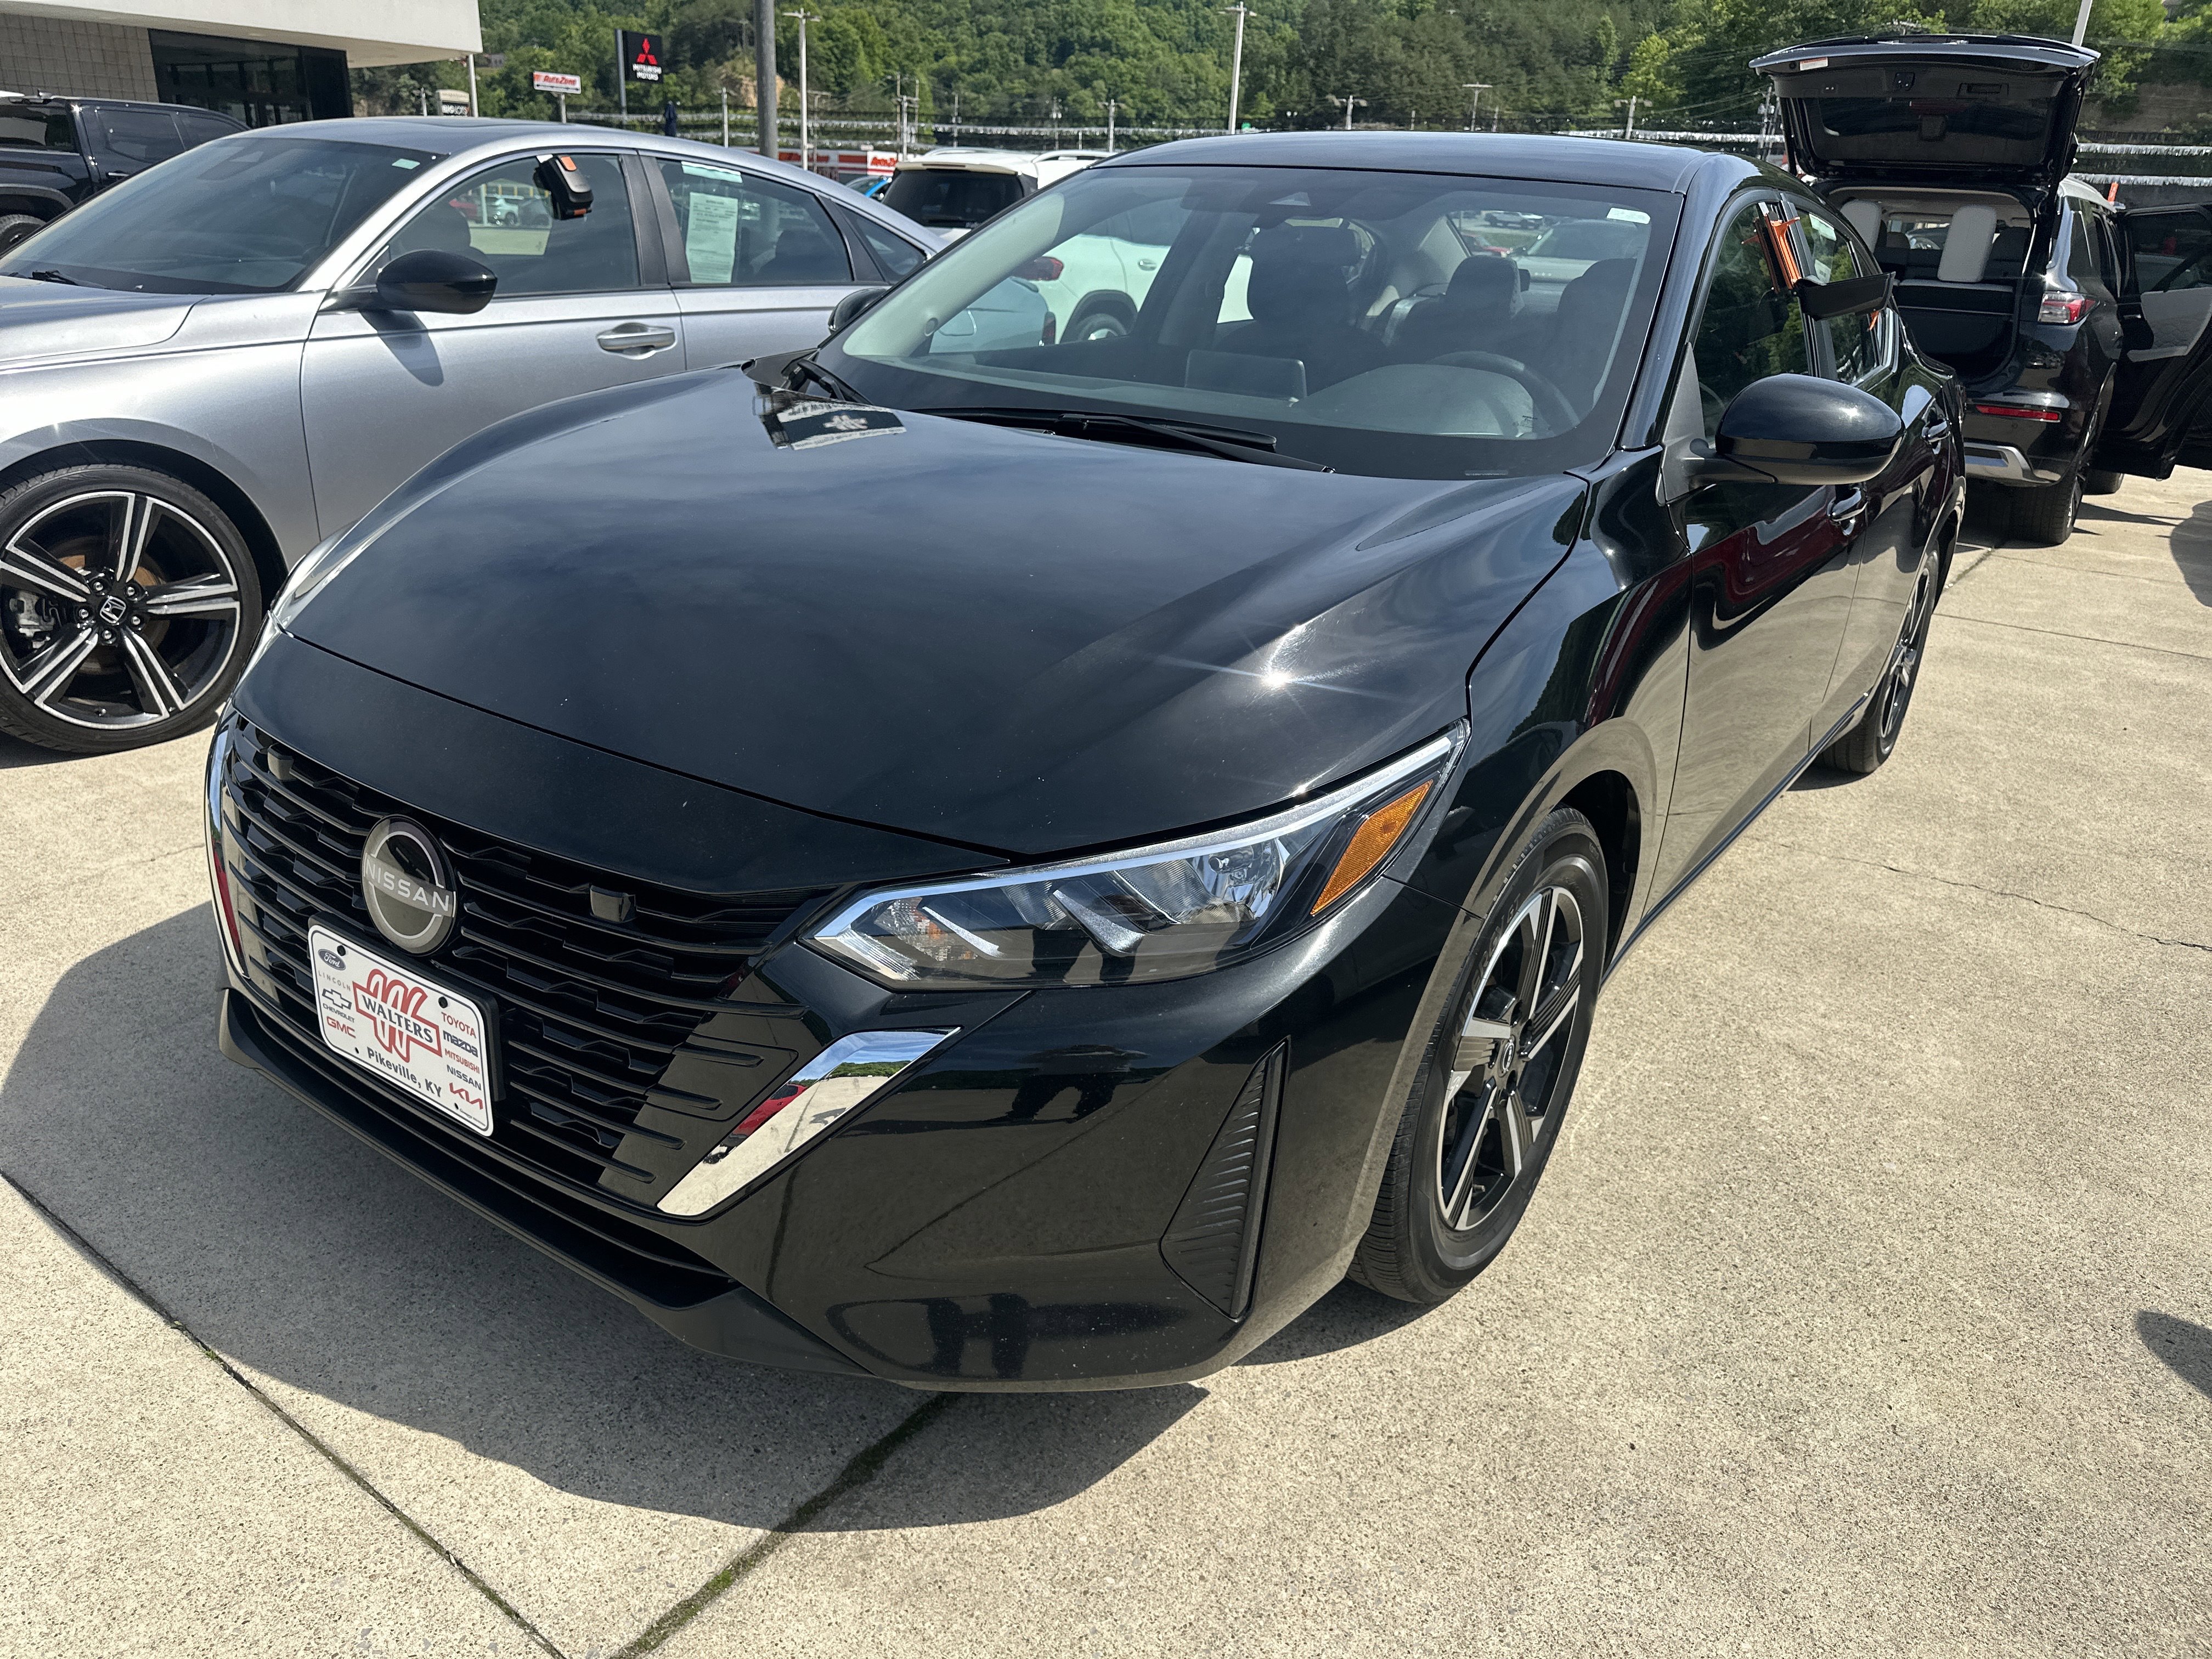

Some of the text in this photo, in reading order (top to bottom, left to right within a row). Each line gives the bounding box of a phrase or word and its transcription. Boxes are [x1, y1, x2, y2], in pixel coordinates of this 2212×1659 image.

[544, 75, 577, 86] AutoZone
[365, 859, 449, 911] NISSAN
[324, 952, 341, 968] Ford
[318, 970, 351, 991] LINCOLN
[323, 1003, 354, 1023] CHEVROLET
[362, 994, 433, 1043] WALTERS
[441, 1012, 477, 1039] TOYOTA
[326, 1016, 356, 1039] GMC
[366, 1046, 442, 1097] Pikeville, KY
[445, 1048, 480, 1074] MITSUBISHI
[447, 1064, 482, 1091] NISSAN
